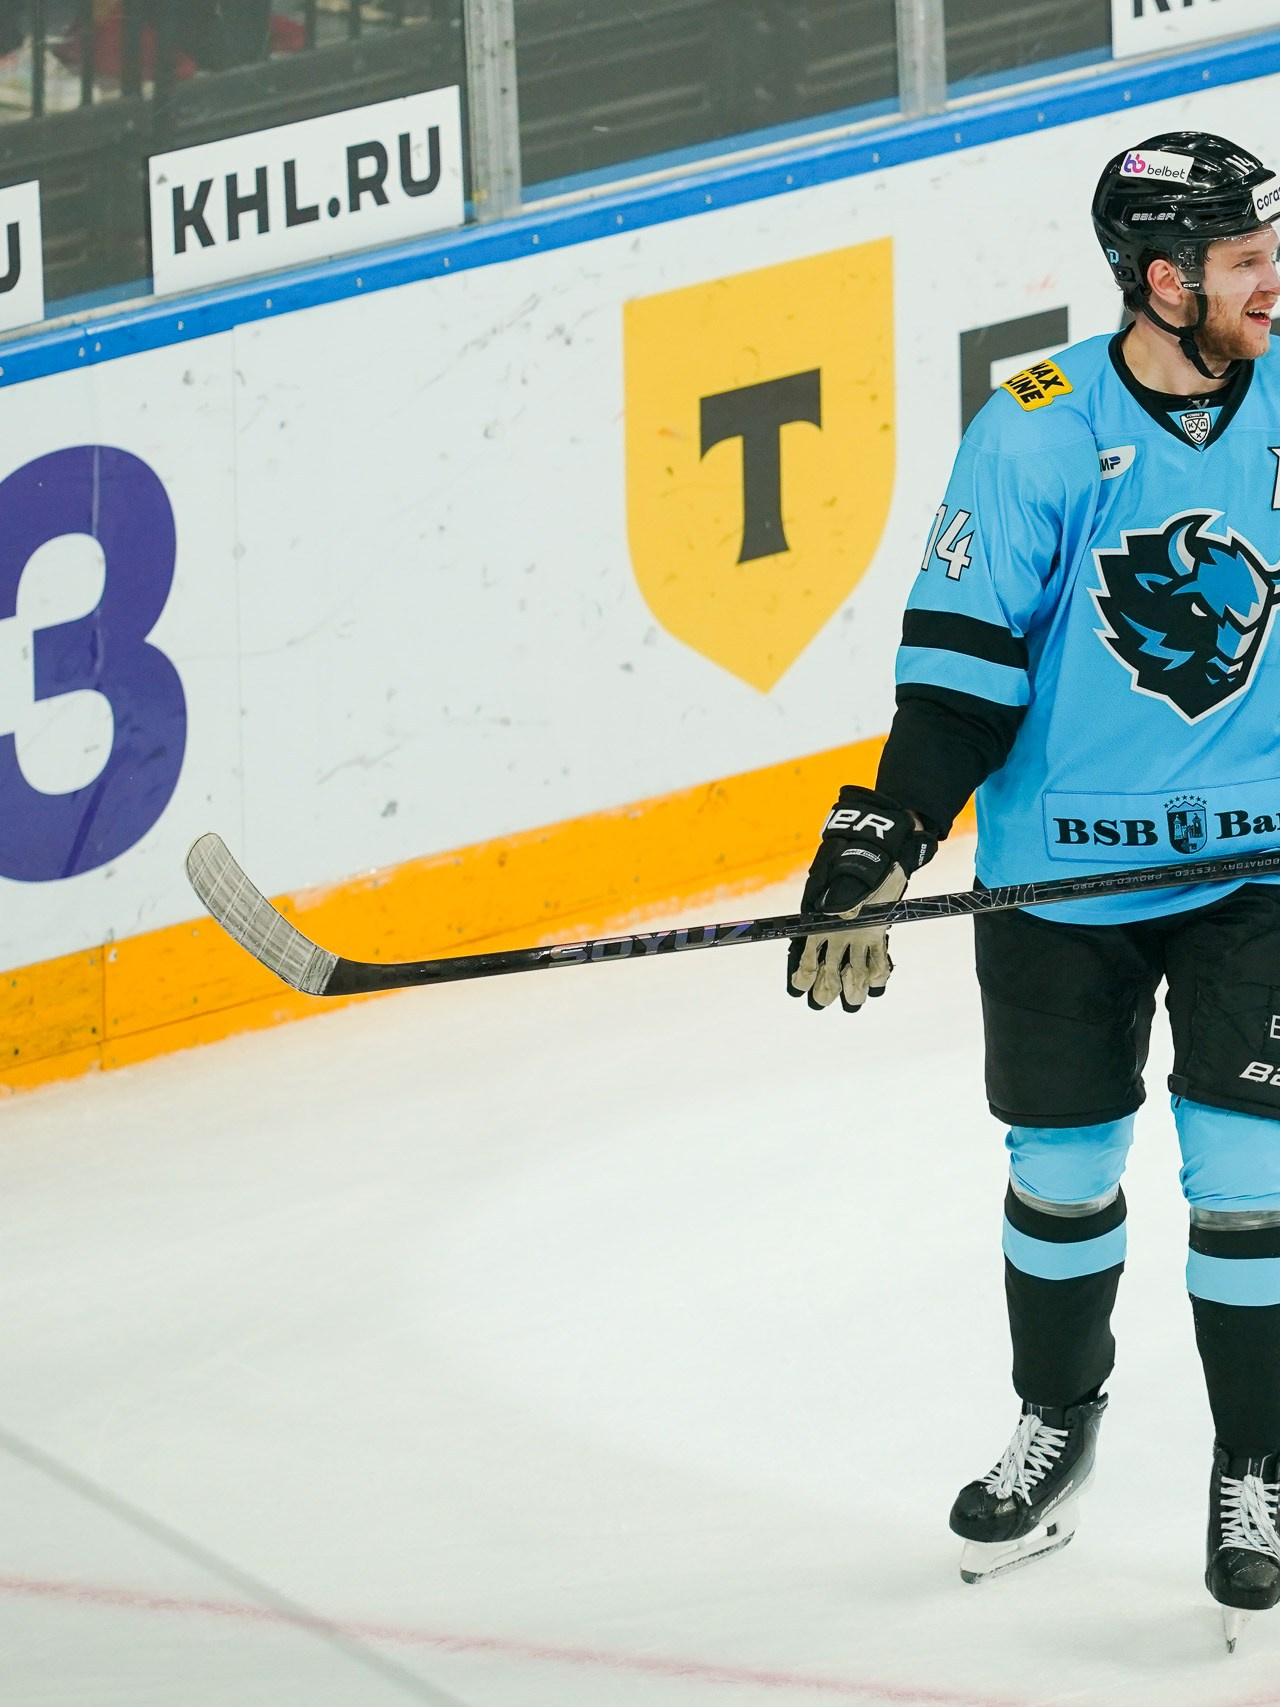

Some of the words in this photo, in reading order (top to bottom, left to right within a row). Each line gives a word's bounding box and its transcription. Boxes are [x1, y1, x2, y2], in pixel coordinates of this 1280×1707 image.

[172, 126, 441, 254] KHL.RU
[1147, 164, 1186, 180] belbet
[1005, 373, 1044, 404] LINE
[921, 503, 975, 582] 14
[0, 445, 188, 882] 3
[1053, 818, 1159, 846] BSB
[1175, 865, 1217, 878] TESTED
[548, 920, 755, 967] SOYUZ
